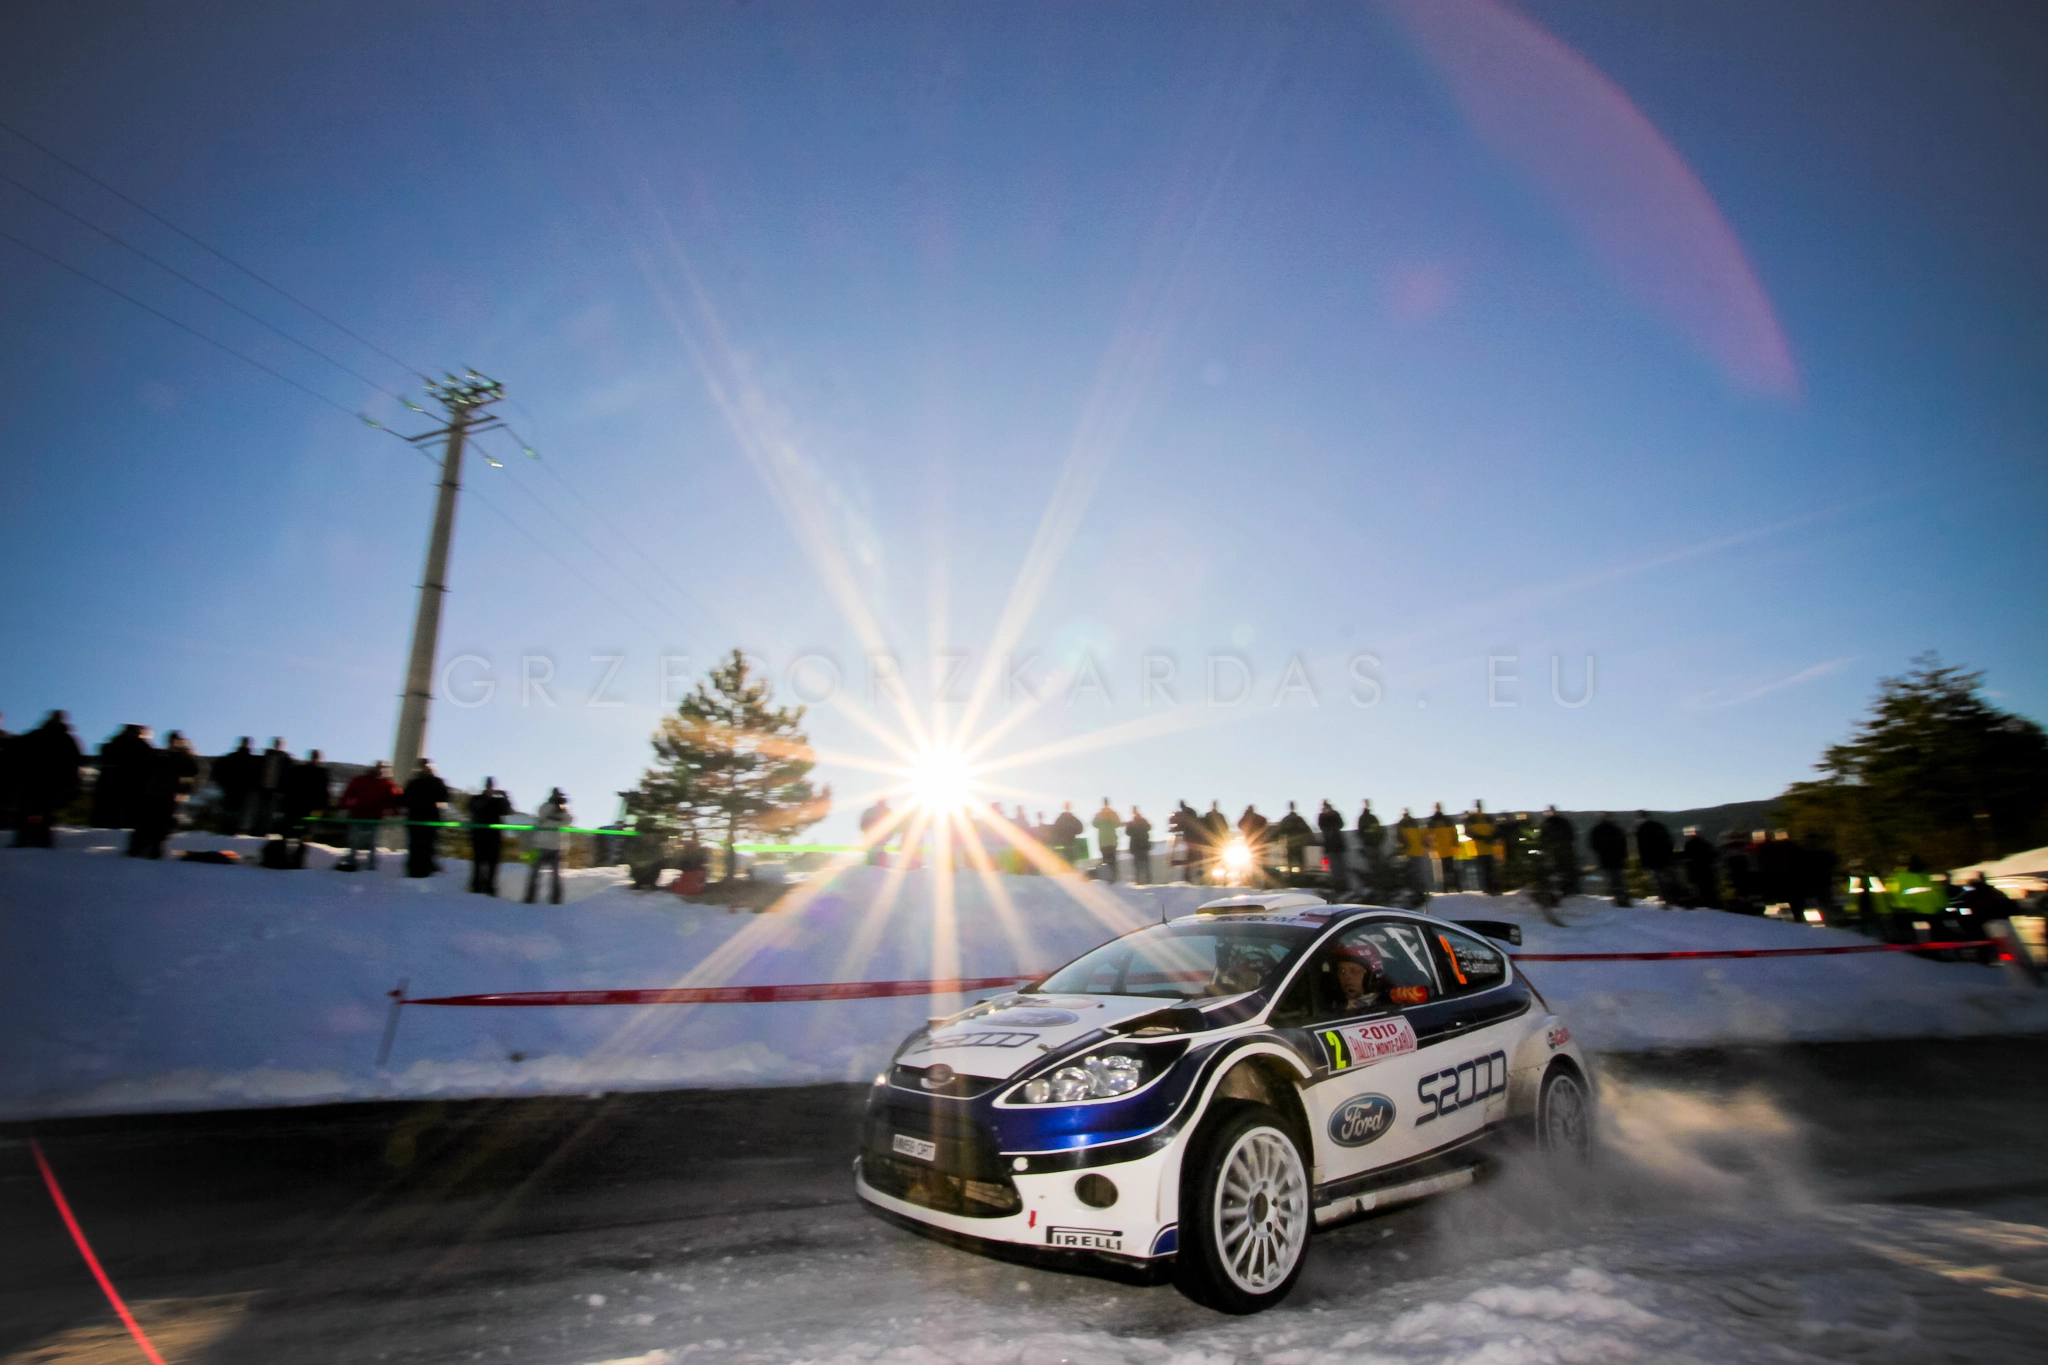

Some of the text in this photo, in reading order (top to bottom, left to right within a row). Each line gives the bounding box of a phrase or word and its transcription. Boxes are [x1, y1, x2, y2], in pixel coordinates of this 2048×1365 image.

[1326, 1031, 1347, 1070] 2
[1359, 1023, 1397, 1040] 2010
[1415, 1050, 1507, 1127] S2000
[1341, 1101, 1384, 1140] Ford
[1046, 1226, 1123, 1251] PIRELLI
